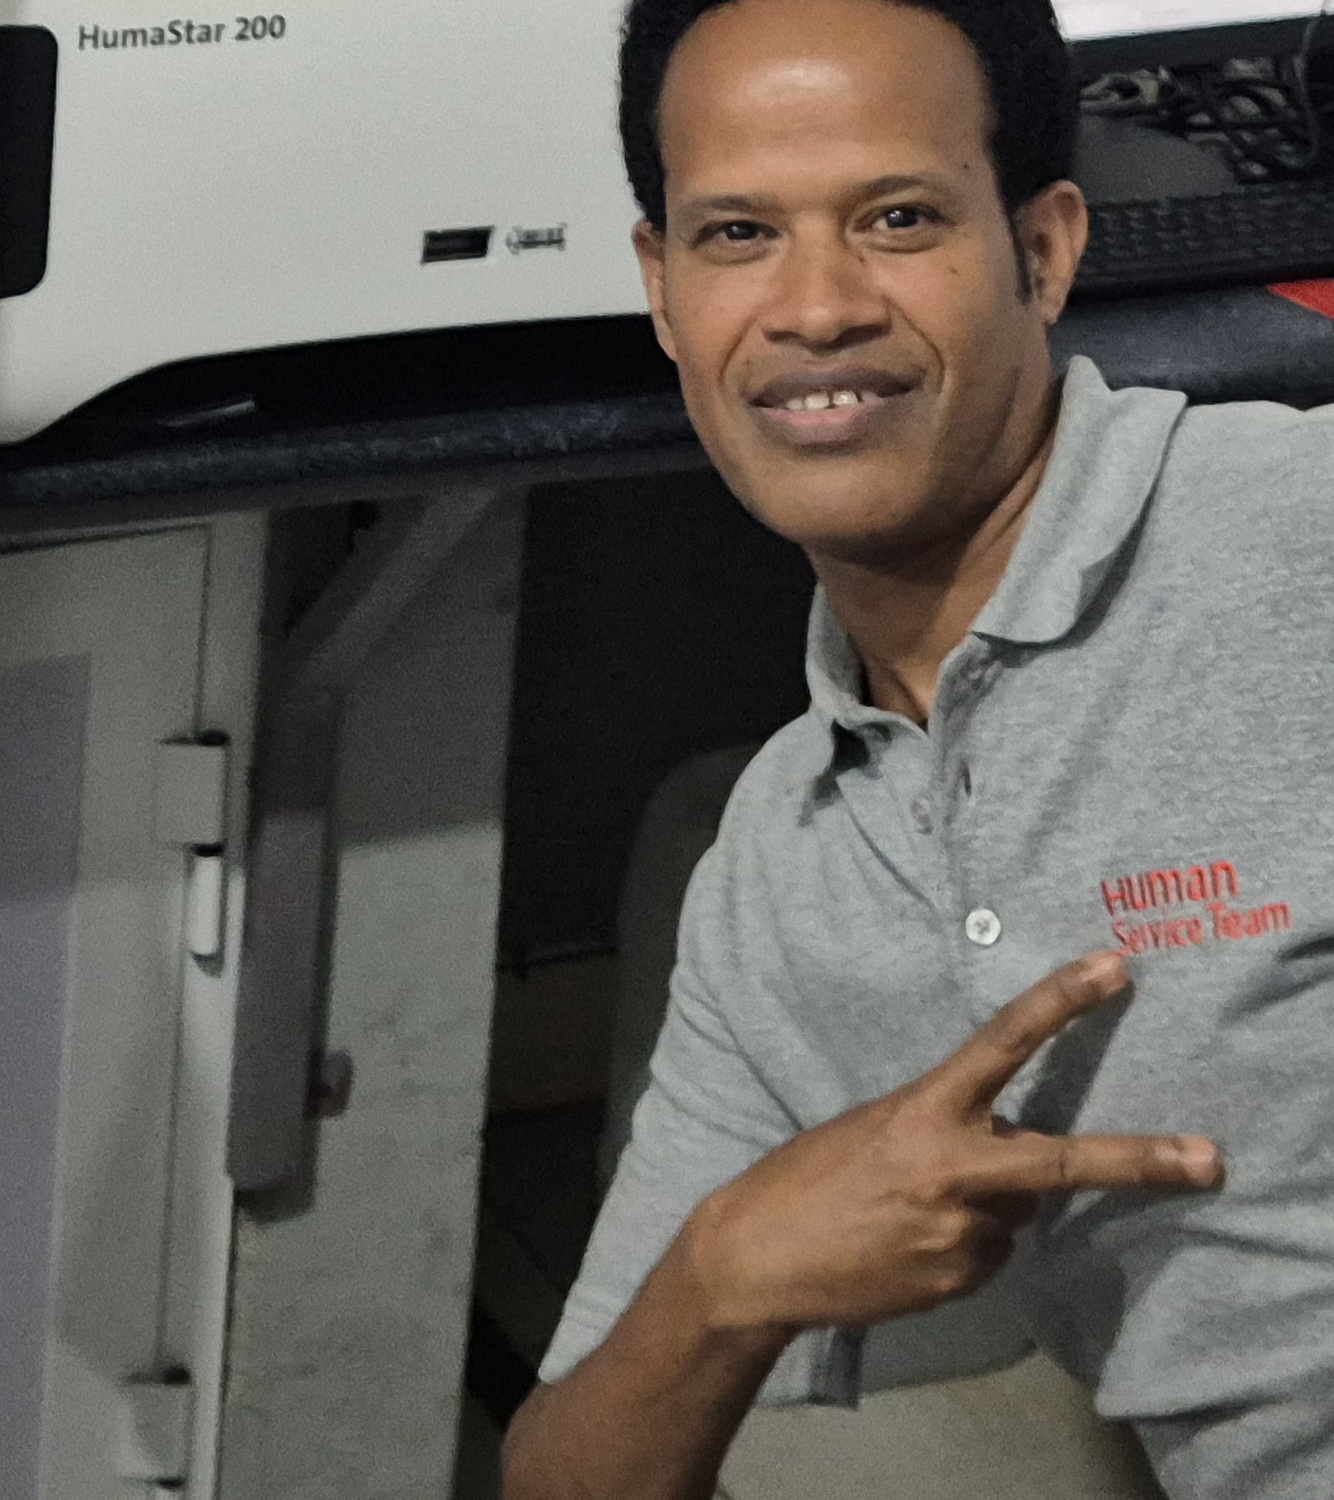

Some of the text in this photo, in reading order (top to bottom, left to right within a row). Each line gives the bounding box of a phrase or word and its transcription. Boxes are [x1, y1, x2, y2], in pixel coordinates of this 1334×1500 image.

[78, 14, 286, 50] HumaStar 200
[1101, 861, 1240, 915] Human
[1207, 902, 1292, 939] Team
